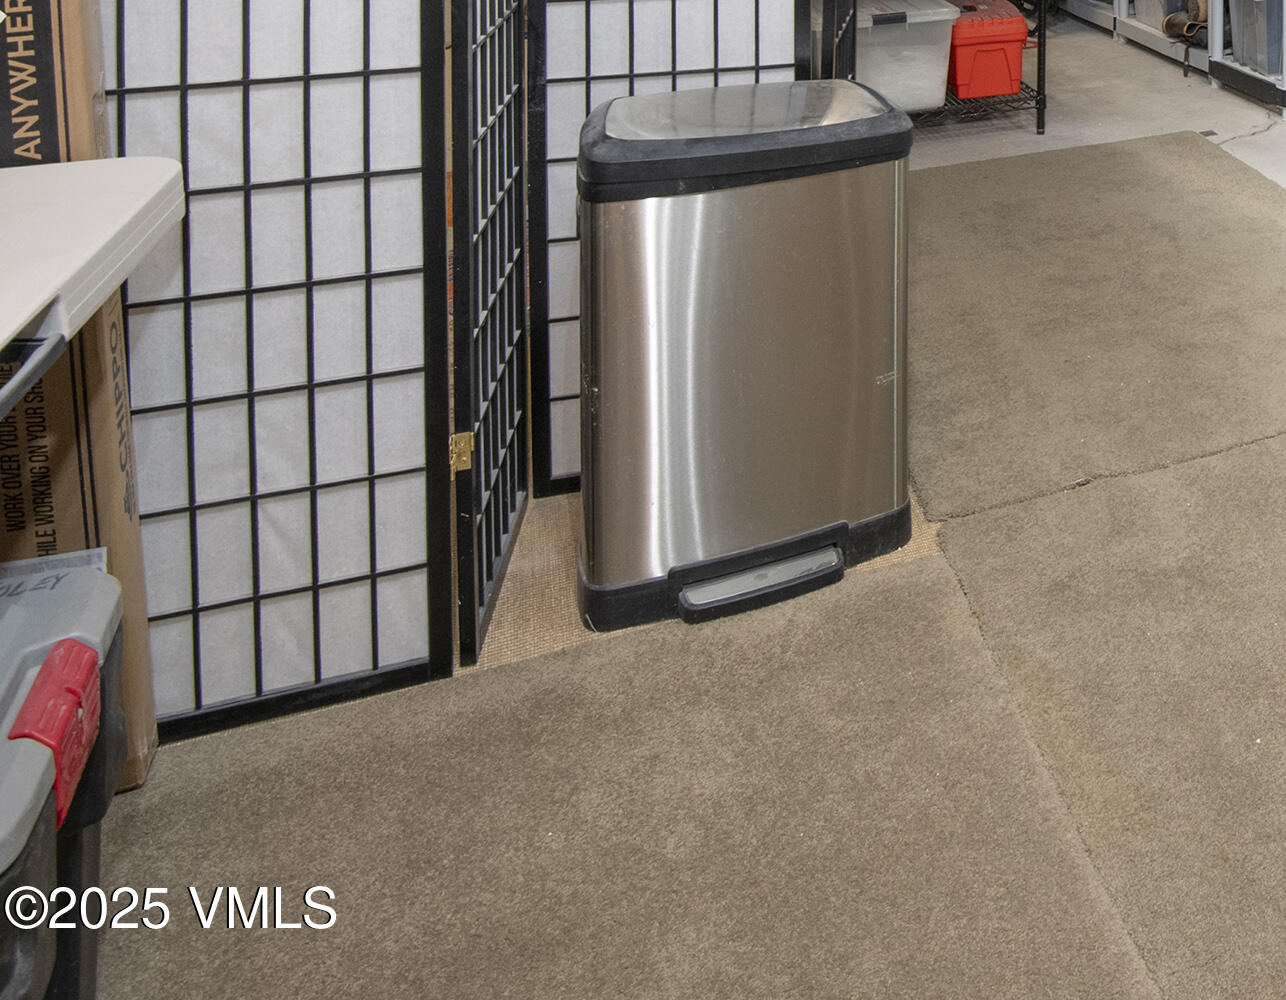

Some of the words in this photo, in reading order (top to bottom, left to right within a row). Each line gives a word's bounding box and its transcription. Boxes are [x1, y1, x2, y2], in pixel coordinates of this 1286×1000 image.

[24, 404, 47, 445] YOUR
[1, 453, 24, 491] OVER
[28, 444, 50, 465] ON
[3, 492, 26, 532] WORK
[30, 464, 55, 527] WORKING
